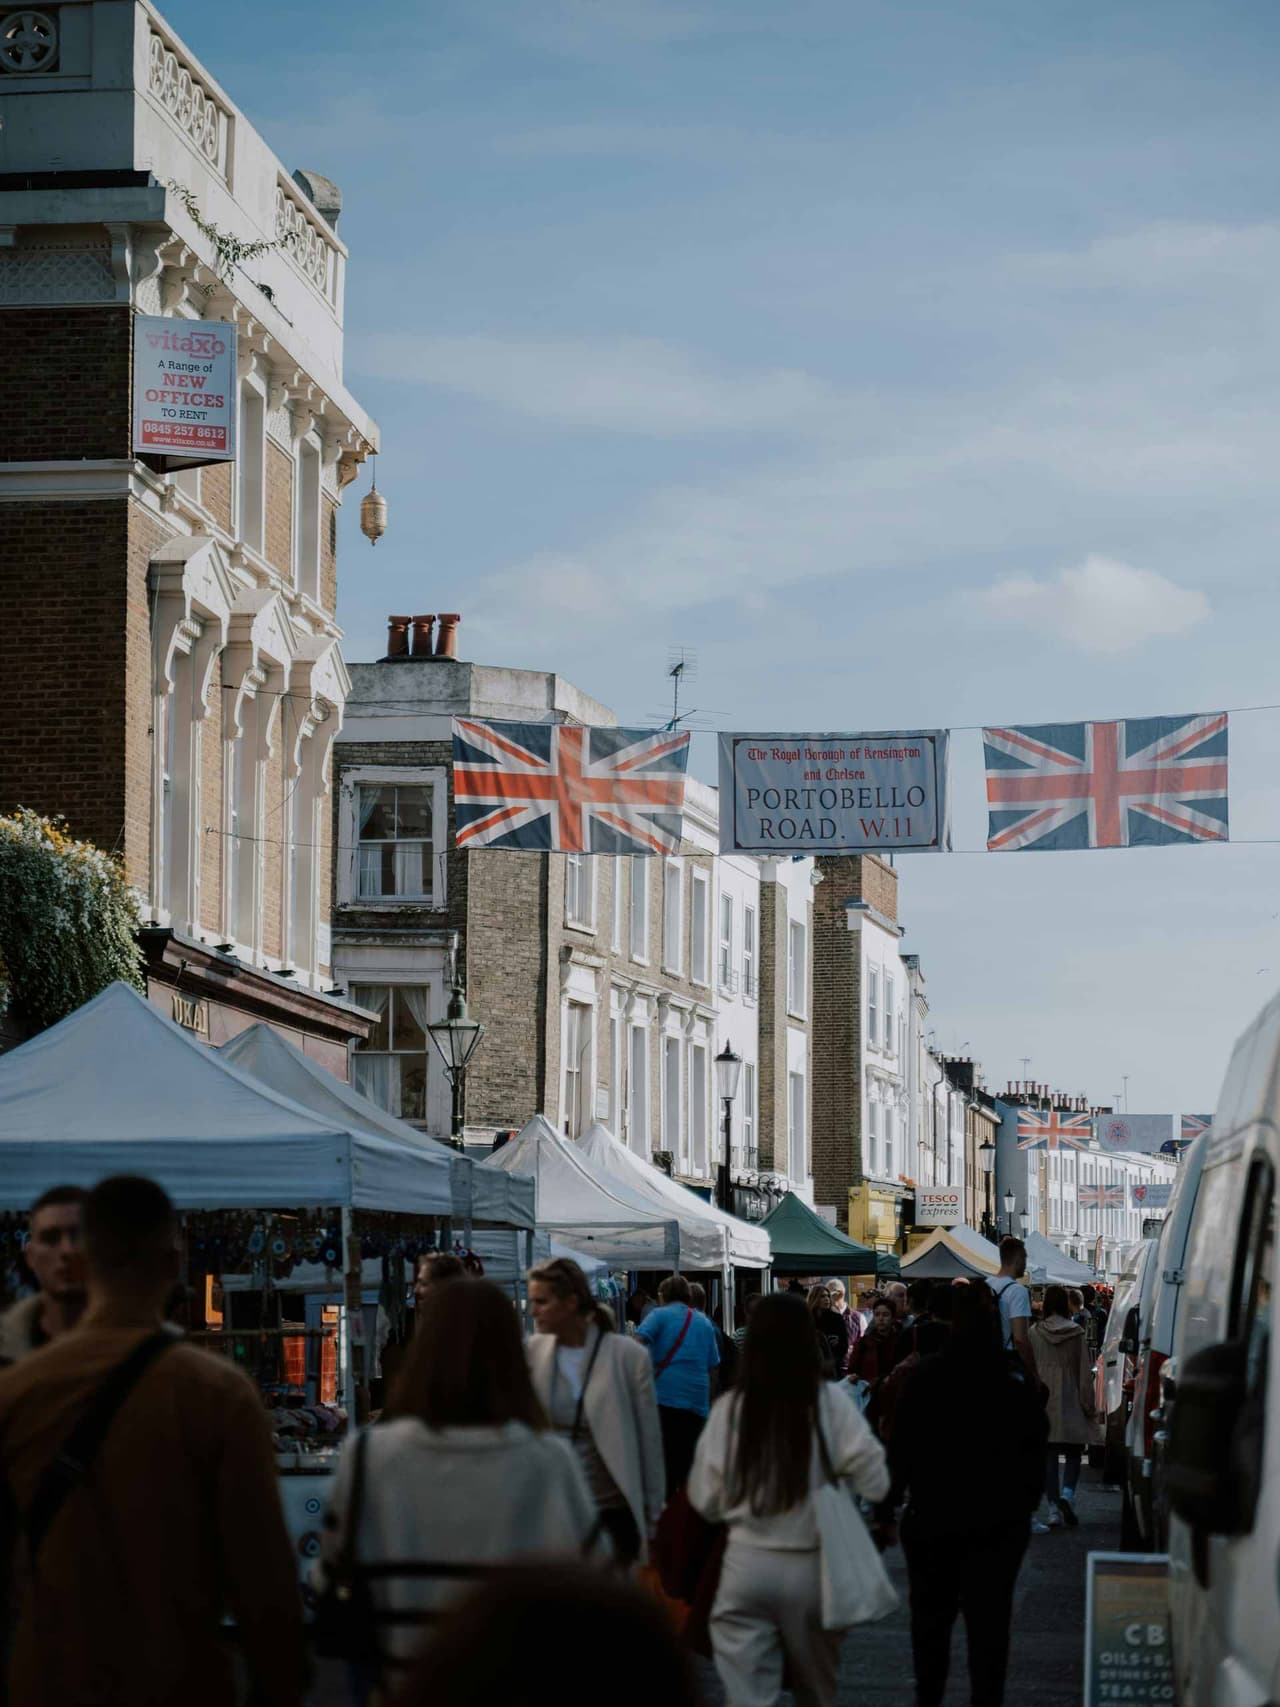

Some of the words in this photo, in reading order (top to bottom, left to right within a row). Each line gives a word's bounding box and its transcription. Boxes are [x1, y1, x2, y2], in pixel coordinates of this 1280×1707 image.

[158, 360, 165, 368] A
[168, 361, 200, 373] Range
[202, 363, 213, 373] of
[163, 373, 207, 389] NEW
[145, 389, 225, 408] OFFICES
[161, 408, 176, 418] TO
[179, 410, 208, 421] RENT
[144, 422, 171, 435] 0845
[174, 425, 194, 437] 257
[197, 427, 225, 440] 8612
[747, 748, 768, 761] The
[770, 748, 801, 764] Royal
[804, 748, 846, 764] Borough
[849, 747, 862, 760] of
[864, 745, 921, 762] Kensington
[803, 768, 821, 781] and
[825, 768, 865, 781] Chelsea
[747, 785, 925, 810] PORTOBELLO
[859, 817, 913, 838] W.11
[173, 995, 208, 1033] UKAI
[920, 1195, 958, 1203] TESCO
[920, 1207, 959, 1218] express
